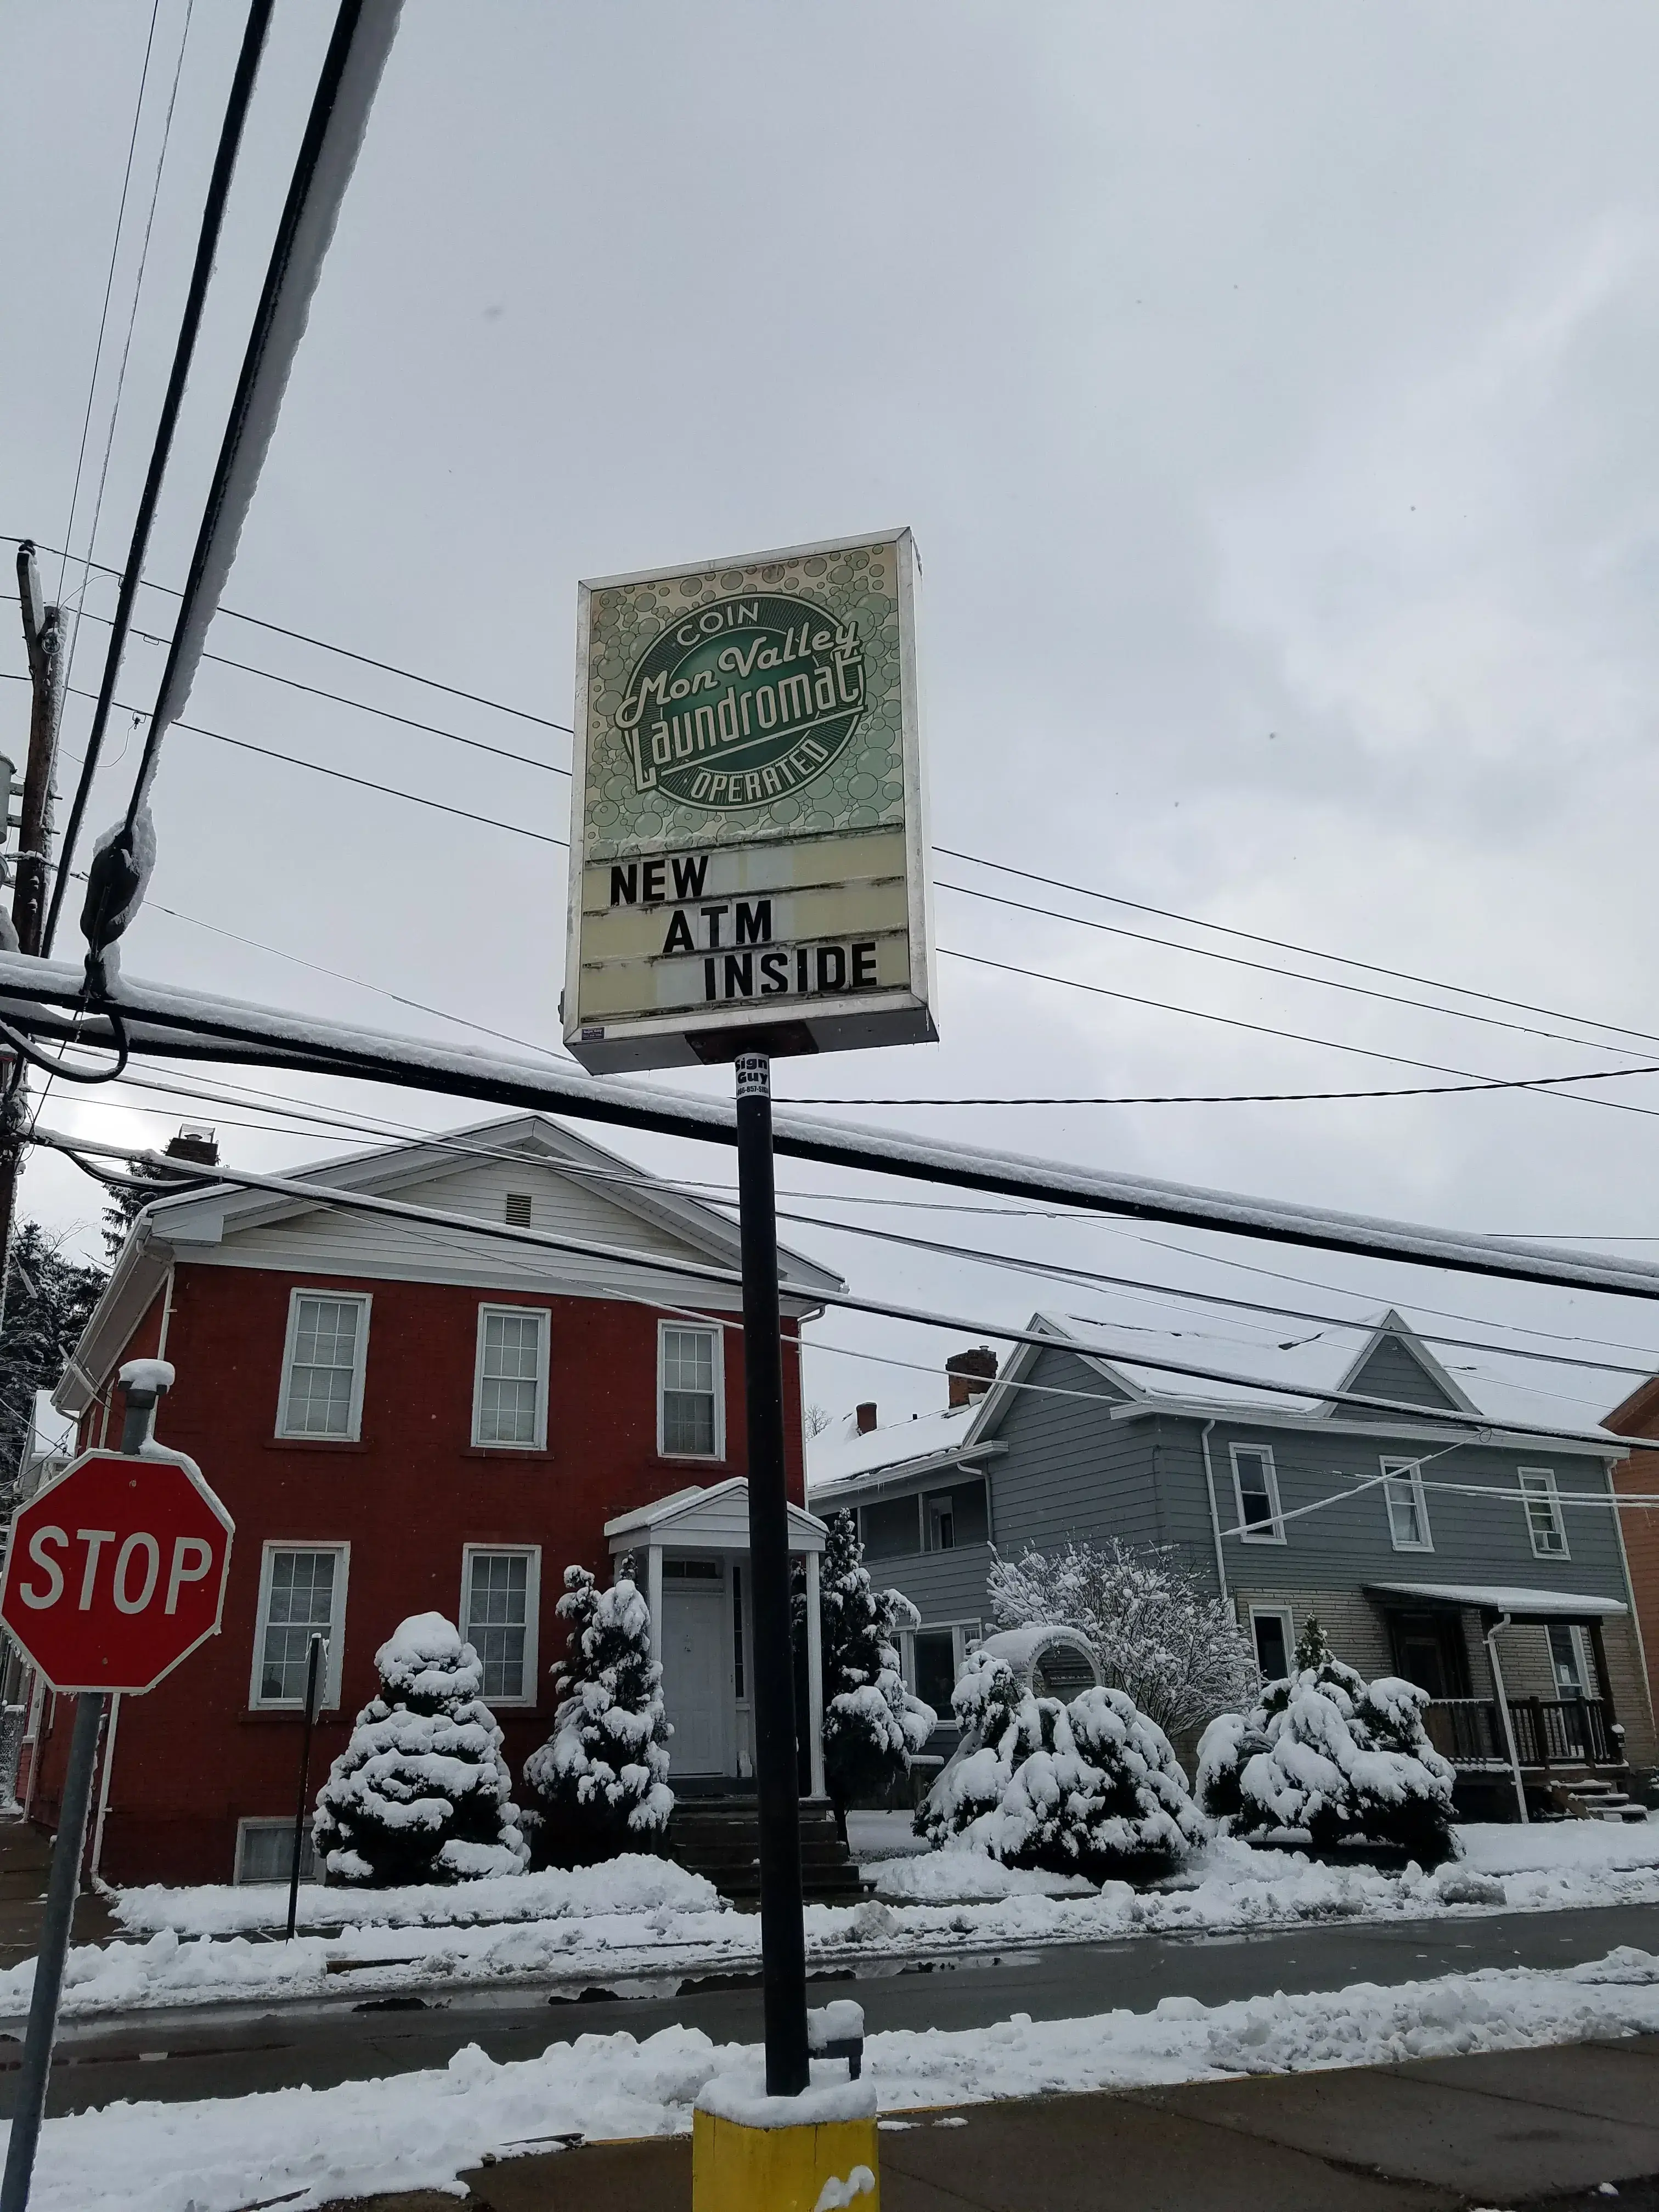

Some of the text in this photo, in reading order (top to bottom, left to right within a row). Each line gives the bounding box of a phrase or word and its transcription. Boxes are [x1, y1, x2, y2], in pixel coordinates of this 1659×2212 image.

[676, 602, 759, 646] COIN
[615, 620, 861, 729] Mon Valley
[631, 651, 864, 790] Laundromat
[691, 739, 828, 803] OPERATED
[610, 855, 709, 906] NEW
[663, 899, 772, 953] ATM
[704, 941, 877, 1001] INSIDE
[735, 1057, 768, 1073] Sign
[737, 1071, 768, 1085] Guy
[20, 1525, 213, 1615] STOP
